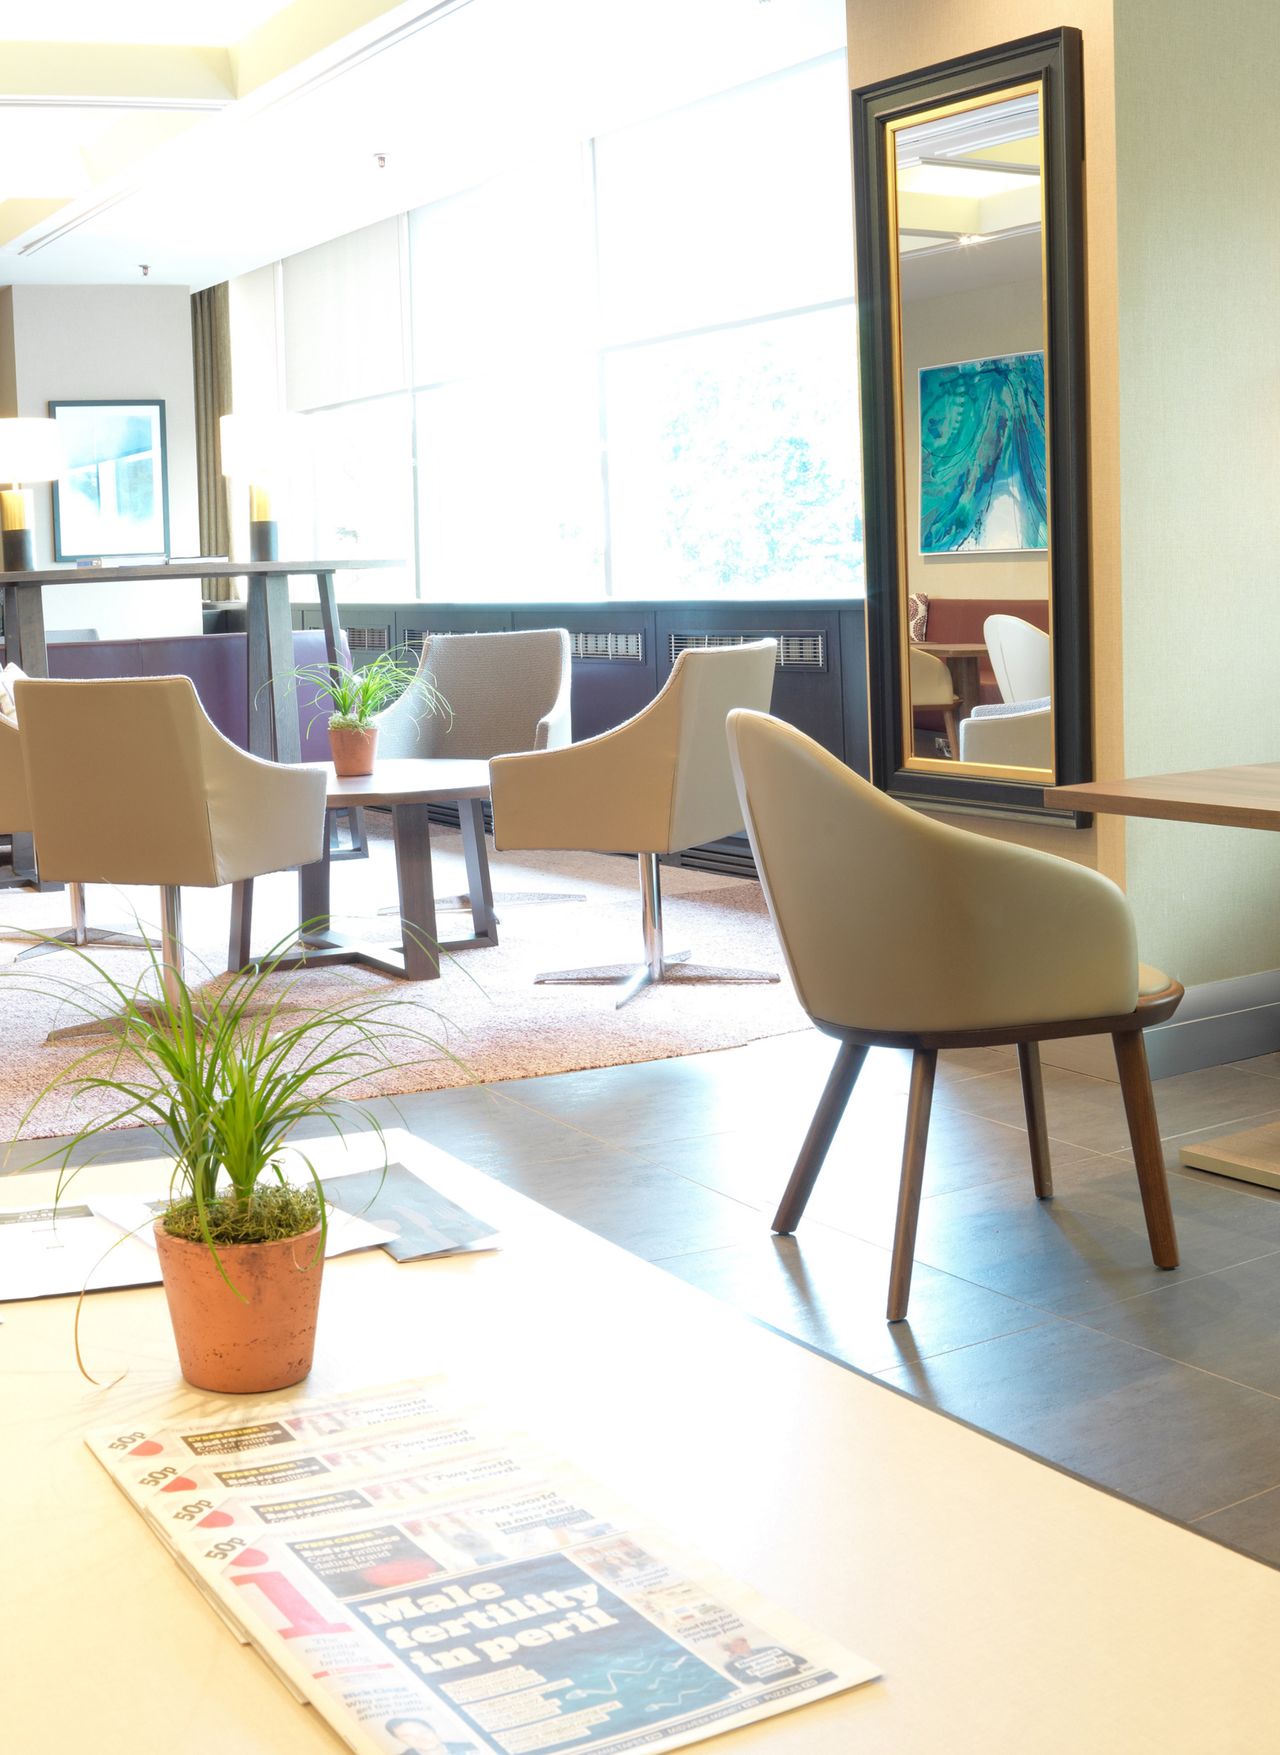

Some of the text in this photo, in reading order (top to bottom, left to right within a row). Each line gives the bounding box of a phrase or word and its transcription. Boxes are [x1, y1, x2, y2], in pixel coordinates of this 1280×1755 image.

[386, 1397, 427, 1410] world
[107, 1430, 147, 1452] 50p
[192, 1430, 282, 1447] Bad romance
[222, 1427, 260, 1437] CRIME
[390, 1429, 469, 1449] Two world
[237, 1436, 273, 1448] online
[421, 1435, 476, 1450] records
[137, 1465, 179, 1487] 50p
[221, 1461, 297, 1479] CYBER CRIME
[226, 1465, 320, 1485] Bad romance
[432, 1457, 515, 1481] Two world
[464, 1464, 521, 1482] records
[173, 1498, 215, 1522] 50p
[258, 1495, 337, 1513] CYBER CRIME
[265, 1498, 361, 1519] Bad romance
[475, 1491, 558, 1516] Two world
[508, 1498, 567, 1517] records
[494, 1504, 576, 1528] in one day
[203, 1534, 249, 1562] 50p
[295, 1531, 374, 1550] CYBER CRIME
[300, 1535, 400, 1558] Bad romance
[306, 1543, 393, 1565] Cost of online
[314, 1551, 391, 1573] dating fraud
[319, 1561, 377, 1577] revealed
[359, 1582, 505, 1626] Male
[385, 1583, 600, 1649] fertility
[304, 1641, 361, 1654] essential
[409, 1605, 620, 1674] in peril
[319, 1655, 373, 1667] briefing
[764, 1684, 801, 1702] PUZZLES
[345, 1697, 373, 1709] Why
[356, 1705, 373, 1716] get
[374, 1701, 393, 1711] the
[358, 1709, 391, 1722] about
